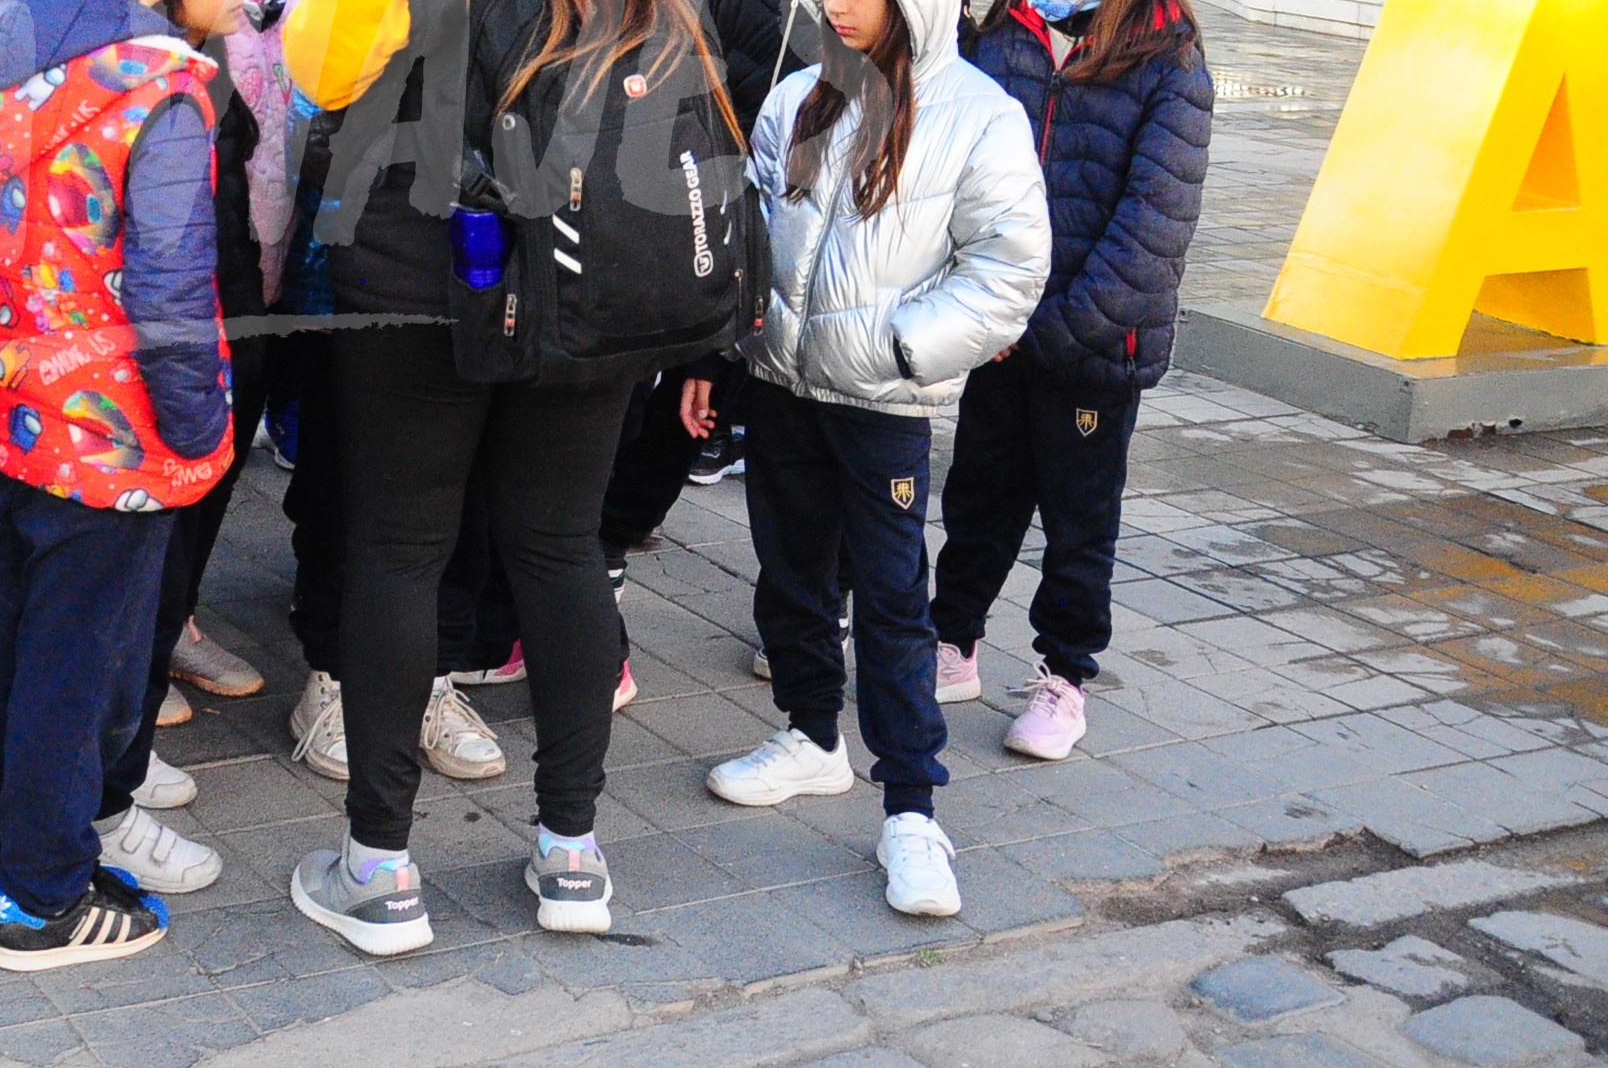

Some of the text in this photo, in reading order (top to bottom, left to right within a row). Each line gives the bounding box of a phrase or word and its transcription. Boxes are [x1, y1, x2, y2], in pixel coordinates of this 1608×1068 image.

[679, 150, 709, 255] TORAZZO GEAR
[556, 877, 592, 891] Topper
[384, 896, 420, 912] Topper
